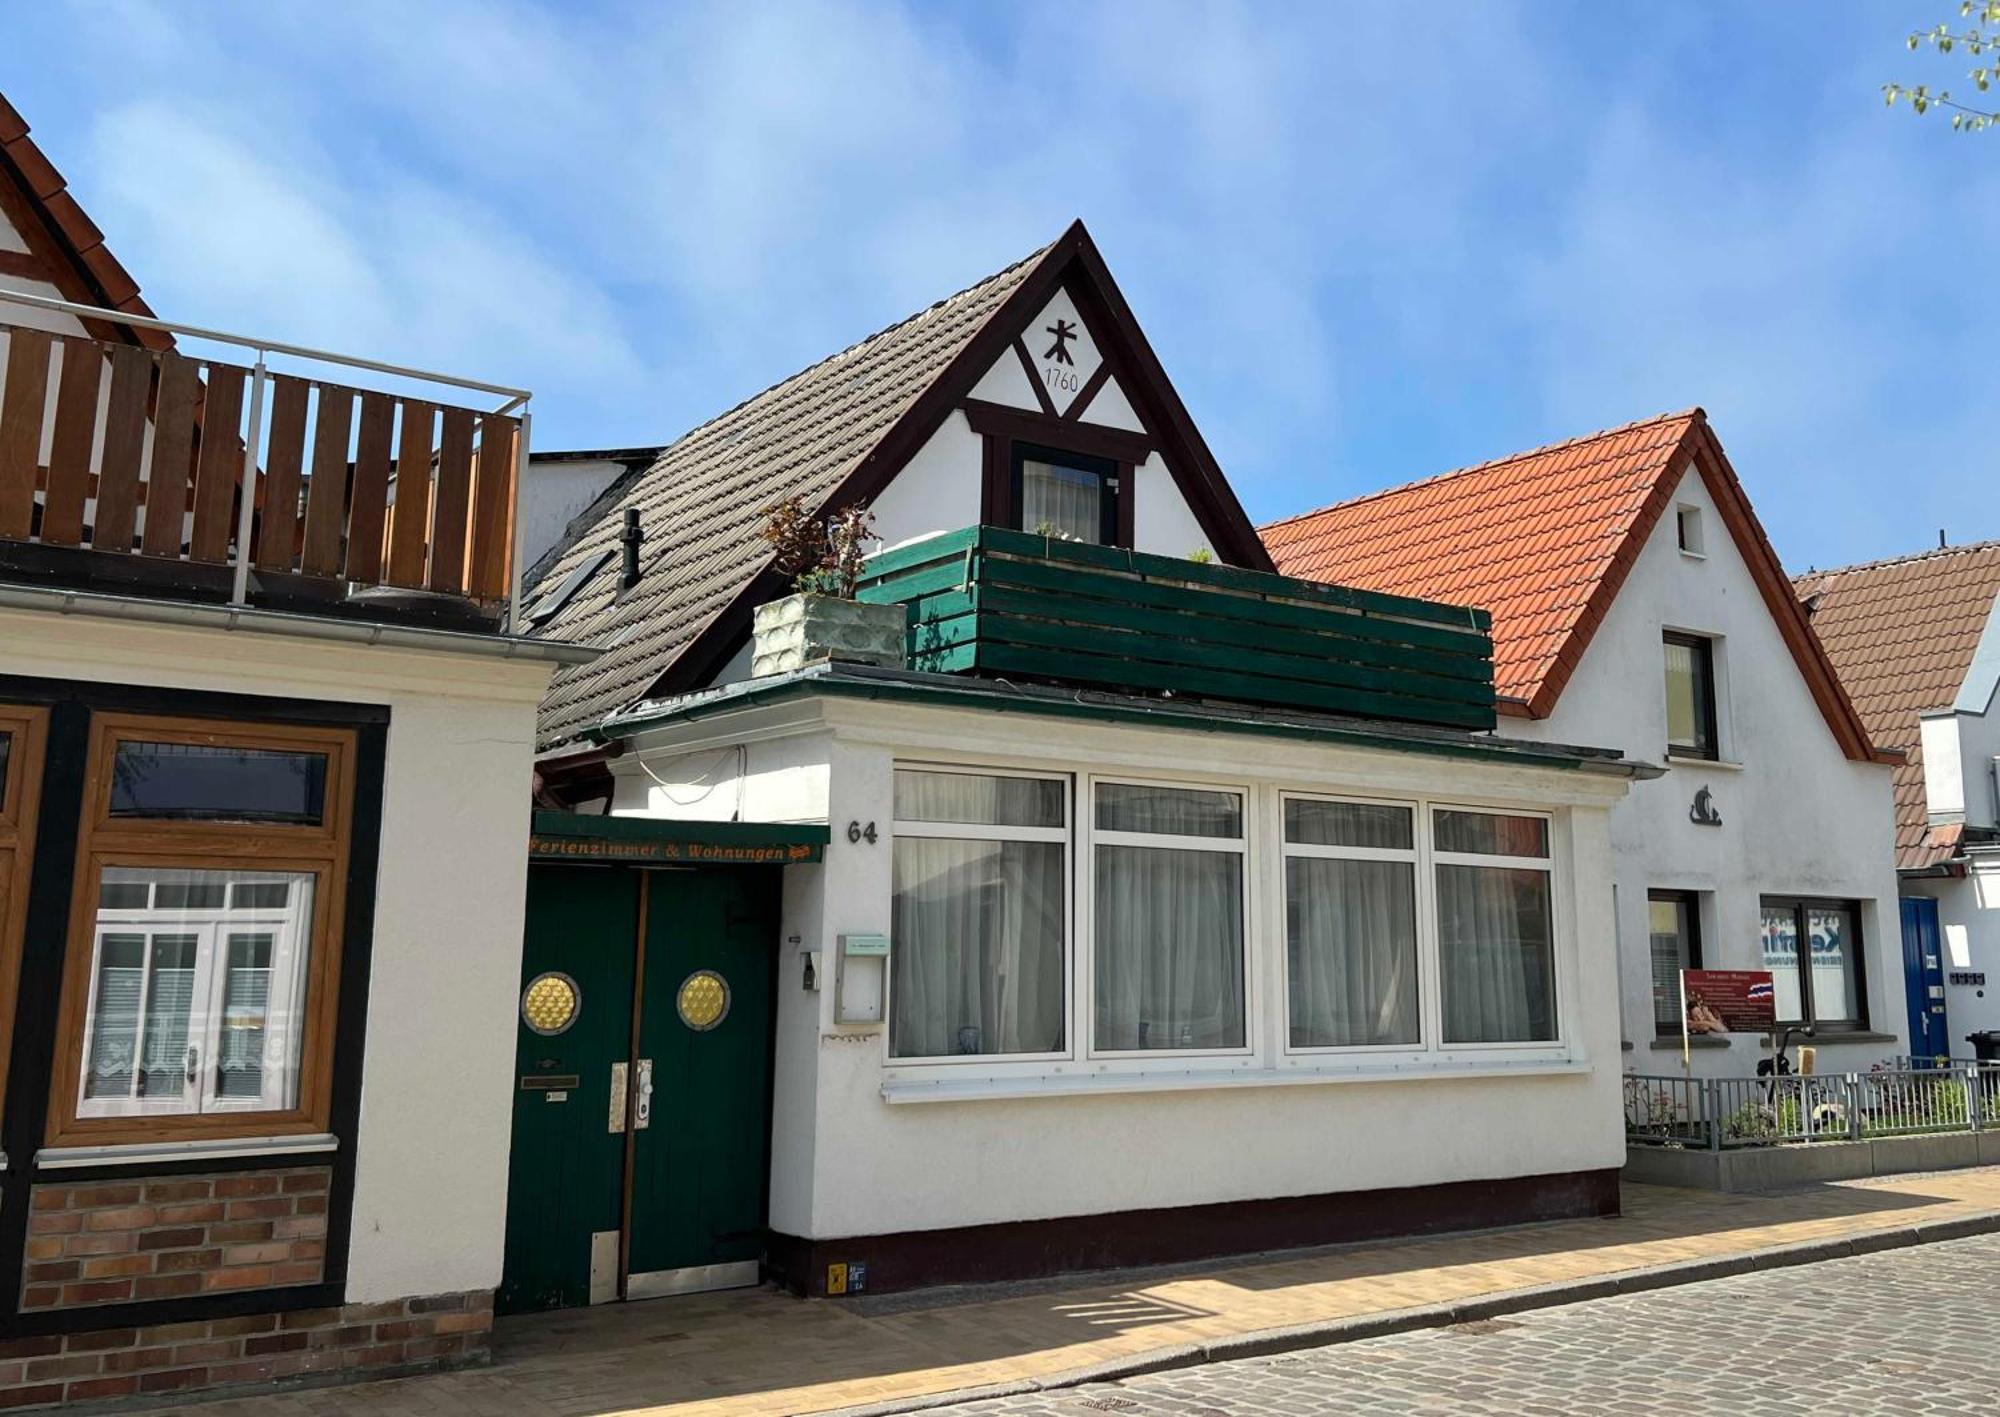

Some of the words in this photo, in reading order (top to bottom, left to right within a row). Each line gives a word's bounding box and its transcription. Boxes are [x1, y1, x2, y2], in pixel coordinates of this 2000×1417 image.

[1045, 368, 1078, 392] 1760
[848, 820, 878, 845] 64
[665, 843, 680, 859] &
[688, 843, 784, 862] Wohnungen
